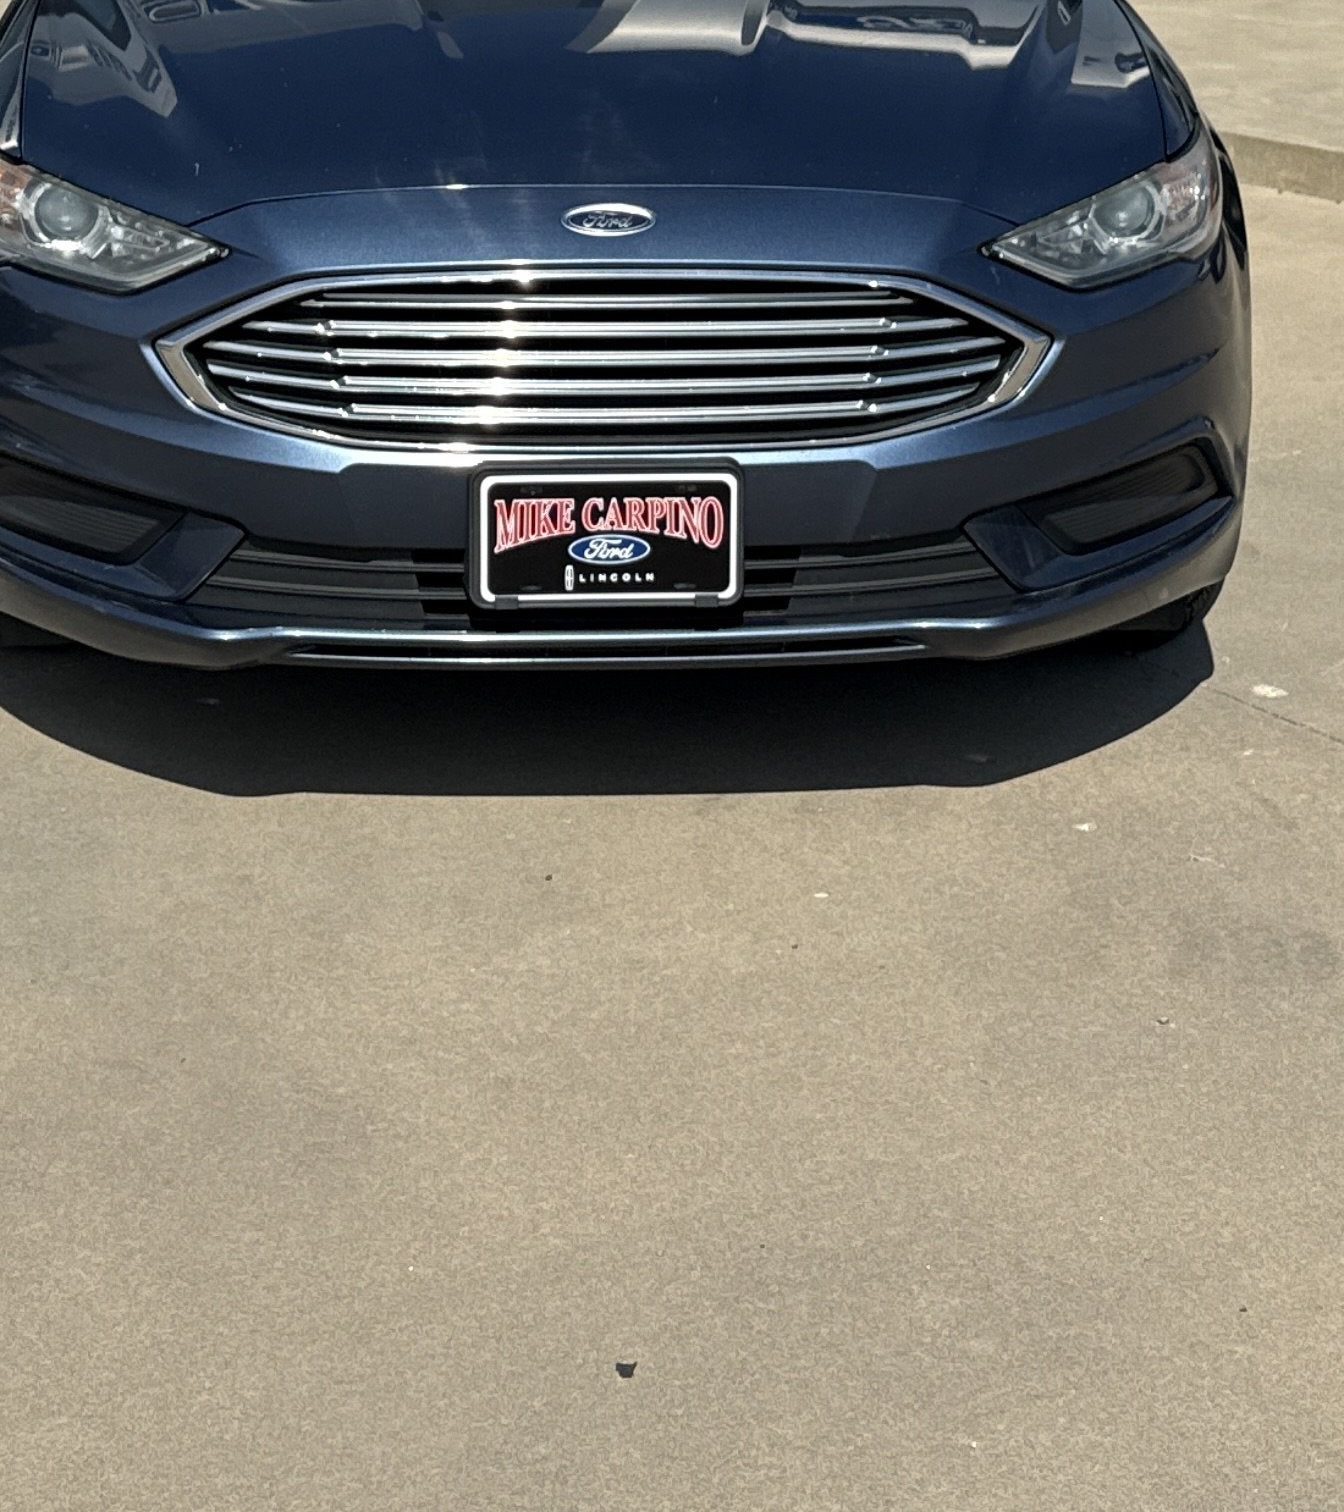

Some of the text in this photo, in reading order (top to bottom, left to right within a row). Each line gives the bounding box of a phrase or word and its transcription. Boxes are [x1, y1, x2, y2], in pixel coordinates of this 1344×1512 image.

[582, 210, 633, 228] Ford
[494, 496, 724, 554] MIKE CARPINO
[583, 538, 634, 560] Ford
[579, 572, 655, 584] LINCOLN
